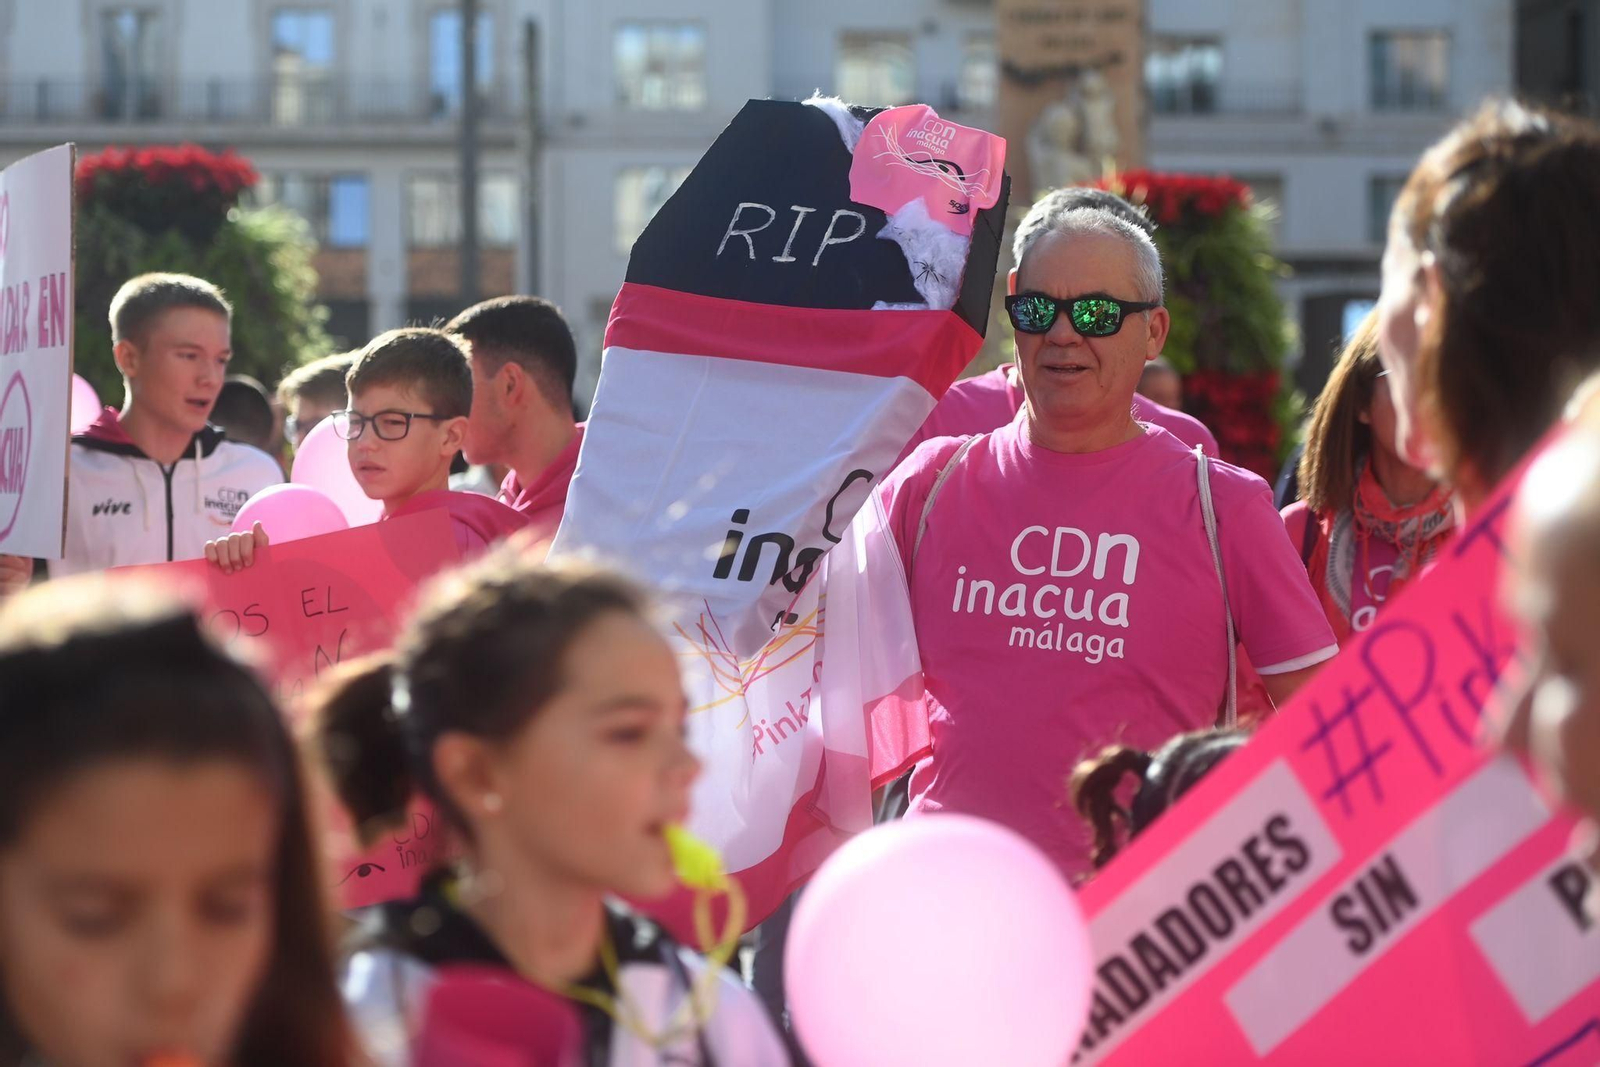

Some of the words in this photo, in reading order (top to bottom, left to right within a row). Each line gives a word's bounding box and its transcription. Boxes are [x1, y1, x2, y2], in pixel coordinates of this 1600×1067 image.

[906, 128, 950, 149] inacua
[716, 201, 867, 266] RIP
[37, 272, 66, 348] EN
[301, 585, 349, 618] EL
[952, 565, 1129, 628] inacua
[1008, 621, 1125, 664] málaga
[1330, 853, 1420, 956] SIN
[1070, 815, 1311, 1064] ADADORES
